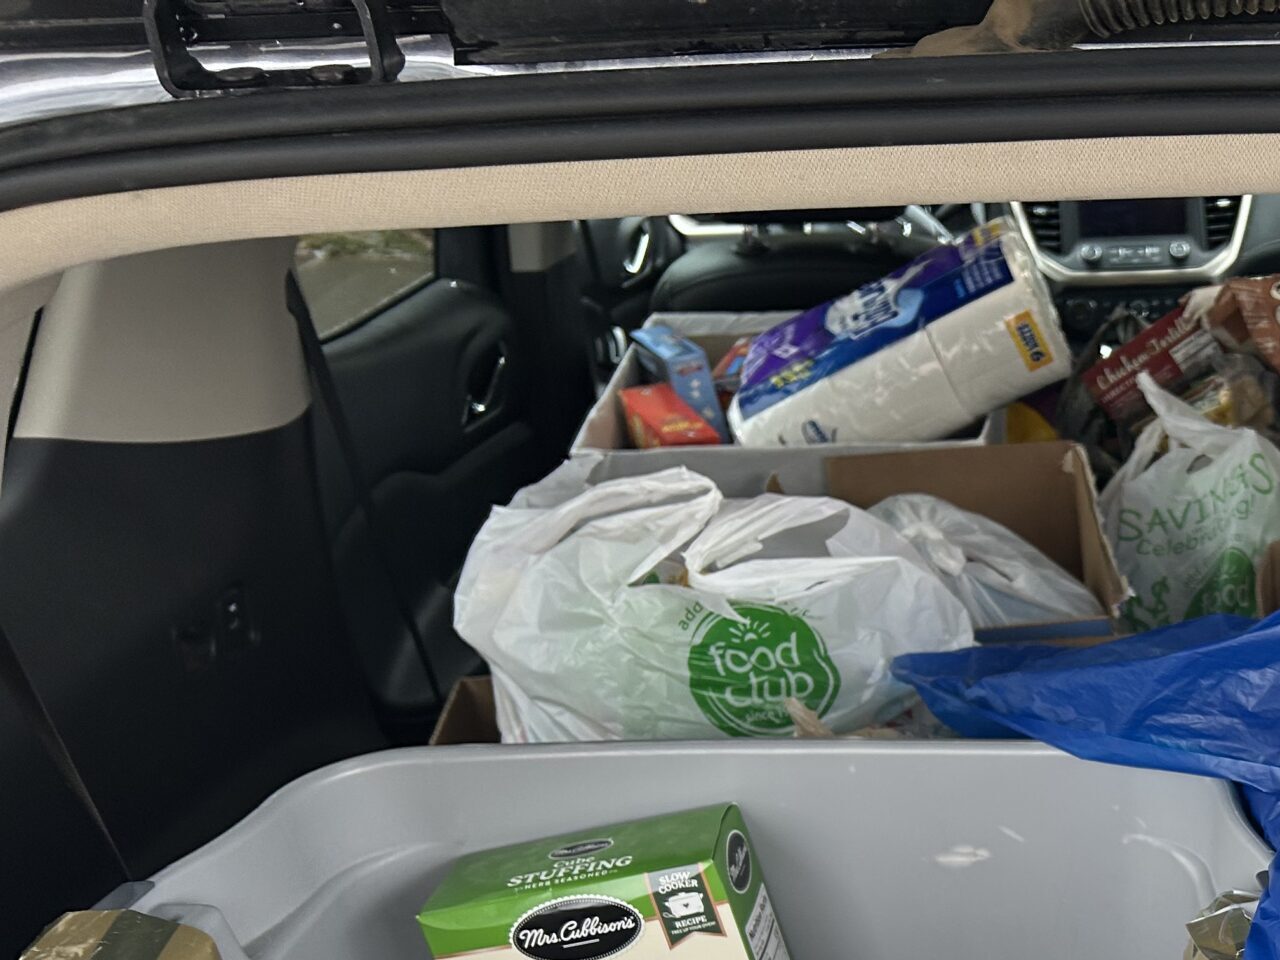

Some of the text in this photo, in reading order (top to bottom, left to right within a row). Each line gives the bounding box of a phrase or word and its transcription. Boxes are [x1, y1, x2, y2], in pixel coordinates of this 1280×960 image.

[709, 631, 800, 677] food
[725, 668, 815, 708] club
[507, 856, 633, 888] STUFFING
[553, 856, 595, 868] Cube
[524, 870, 608, 891] HERB SEASONED
[658, 871, 691, 887] SLOW
[658, 878, 699, 894] COOKER
[519, 915, 636, 949] Mrs. Cubbison's
[674, 915, 708, 929] RECIPE
